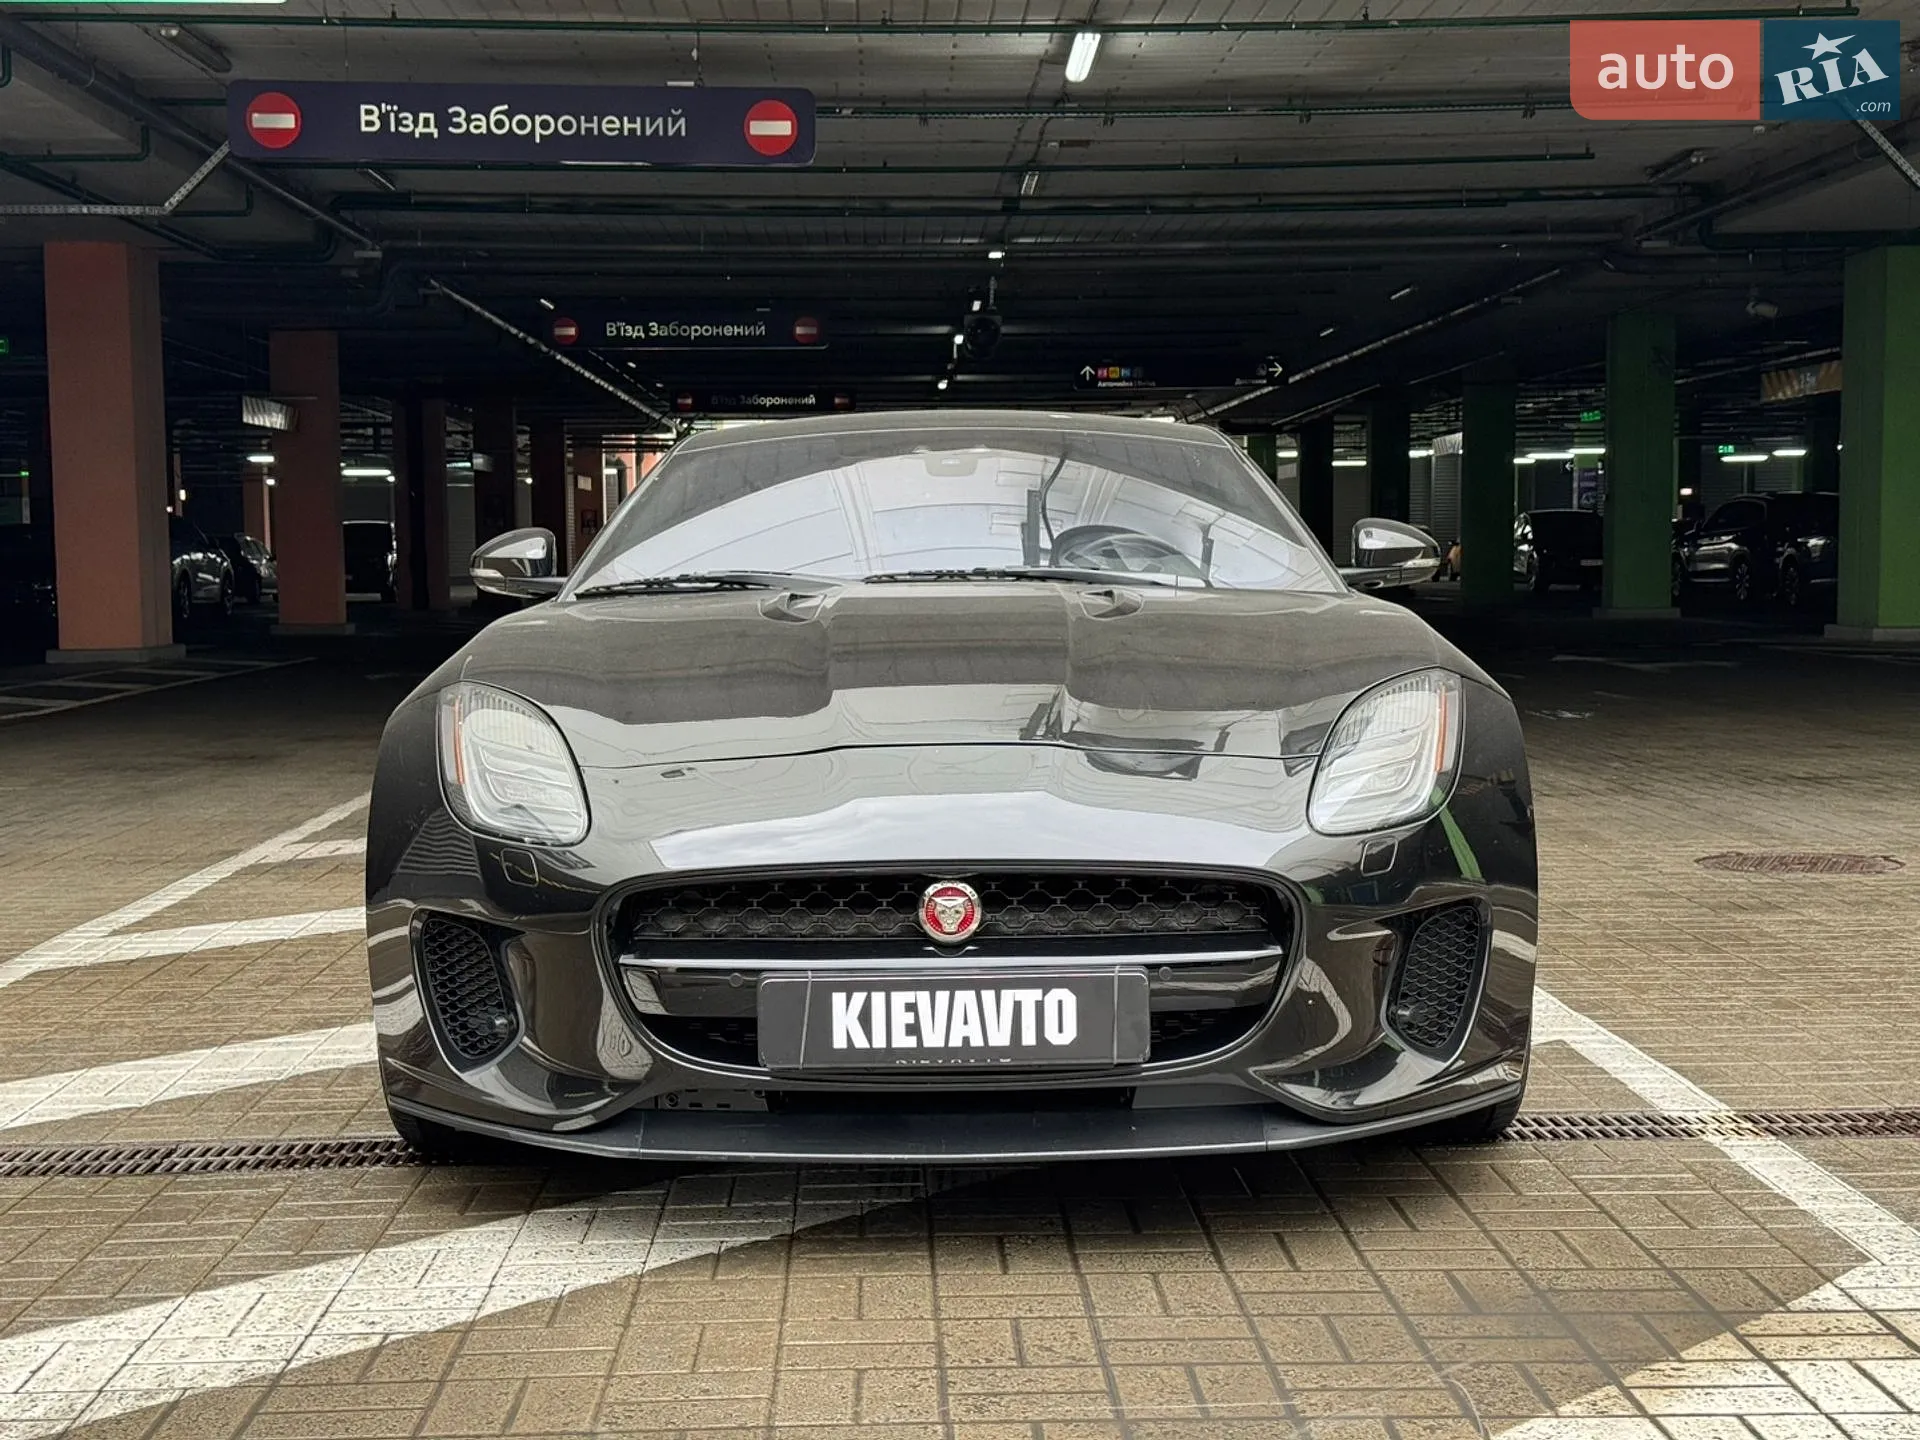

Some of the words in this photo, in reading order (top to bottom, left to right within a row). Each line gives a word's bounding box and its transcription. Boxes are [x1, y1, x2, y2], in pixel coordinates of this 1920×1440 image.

[359, 102, 439, 139] В'їзд
[447, 103, 687, 144] Заборонений
[648, 321, 766, 341] Заборонений
[832, 988, 1077, 1049] KIEVAVTO
